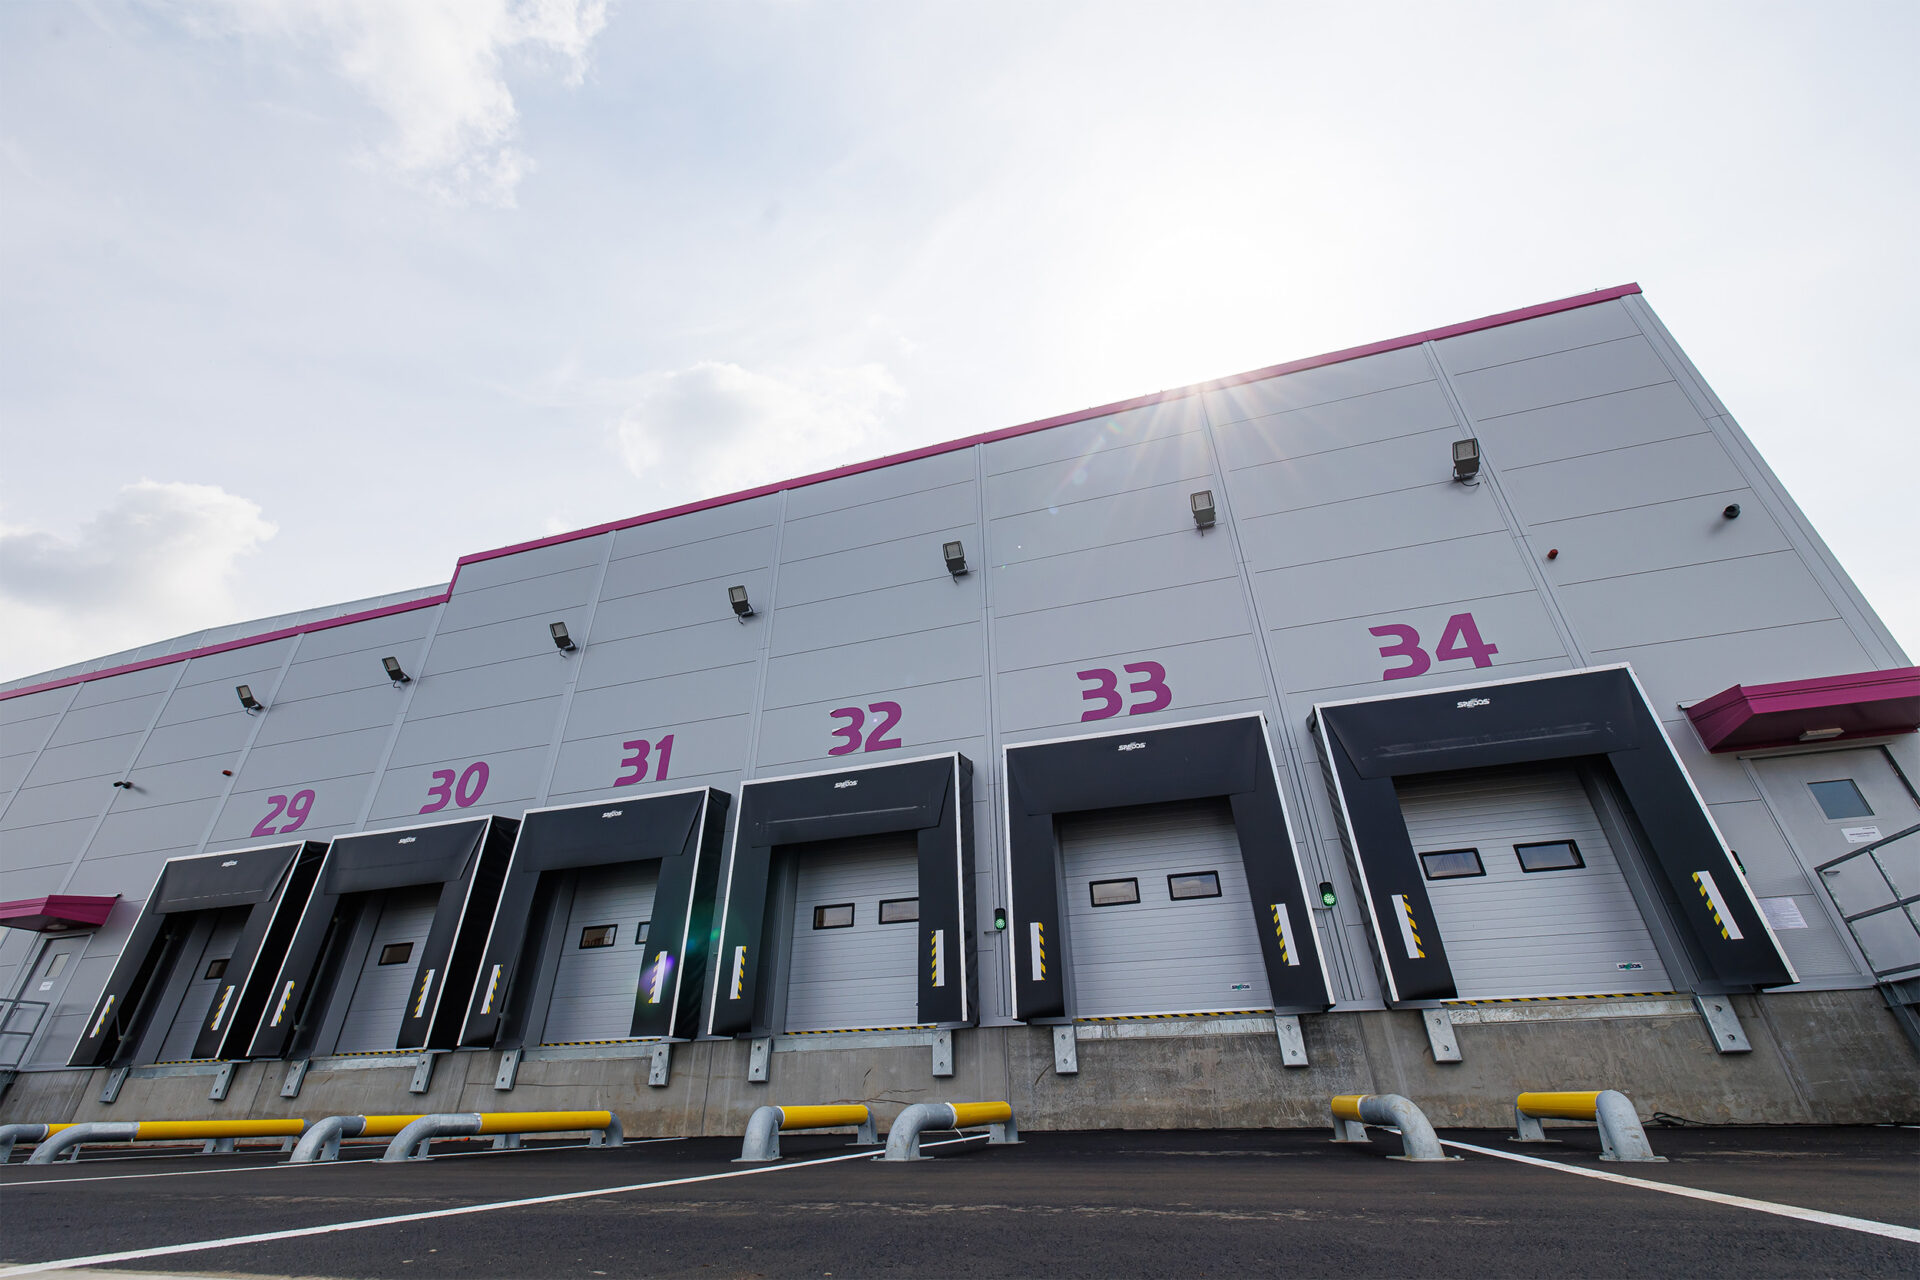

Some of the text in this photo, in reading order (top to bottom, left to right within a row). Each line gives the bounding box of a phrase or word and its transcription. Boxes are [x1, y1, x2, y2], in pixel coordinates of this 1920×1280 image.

[1368, 612, 1499, 681] 34
[1076, 661, 1172, 721] 33
[828, 701, 902, 756] 32
[614, 735, 674, 787] 31
[251, 789, 315, 838] 29
[420, 762, 490, 815] 30
